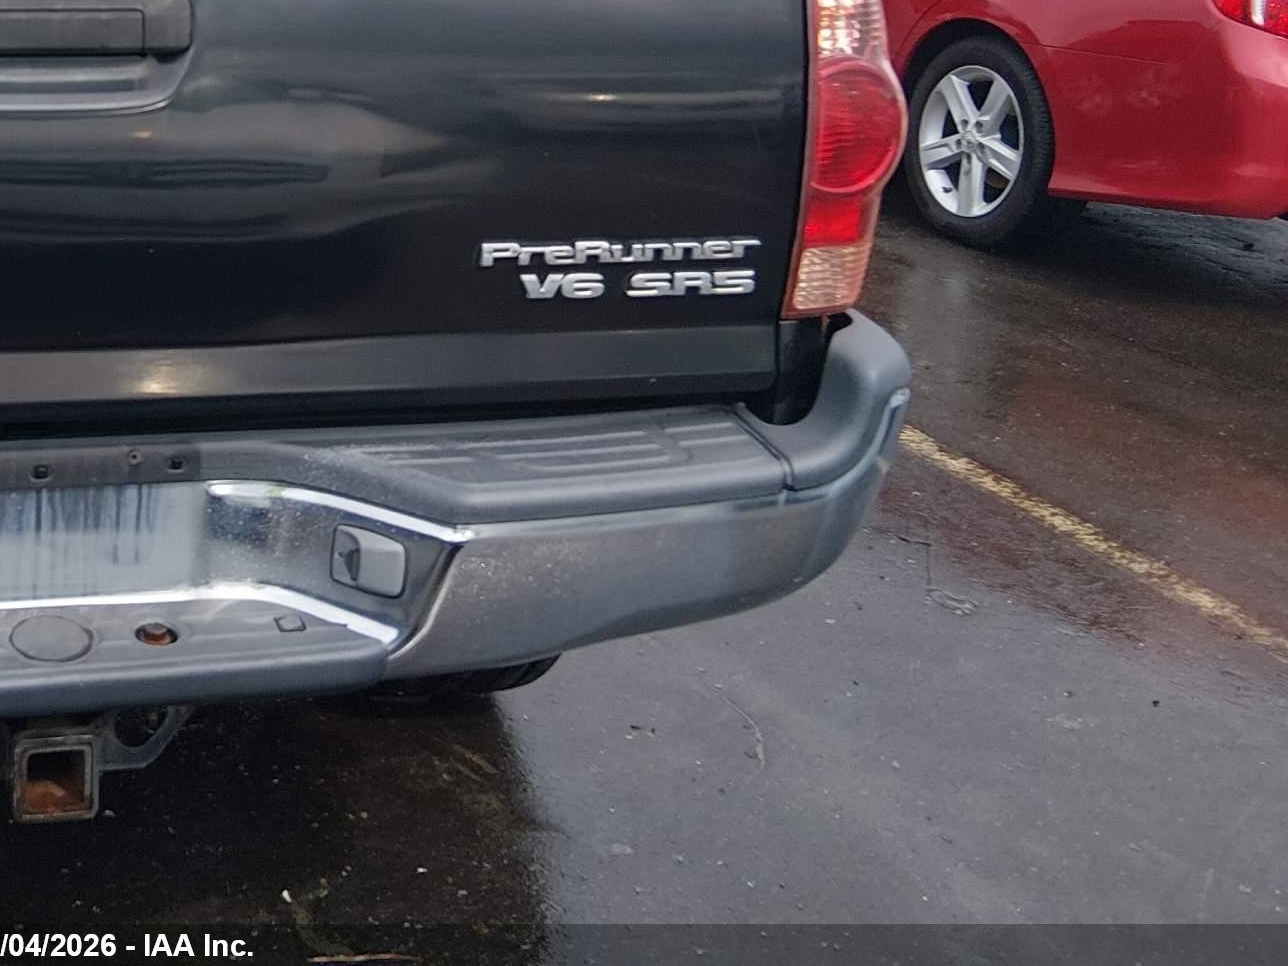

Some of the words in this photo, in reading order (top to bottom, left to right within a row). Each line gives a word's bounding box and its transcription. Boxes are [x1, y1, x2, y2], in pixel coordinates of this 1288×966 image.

[480, 239, 762, 267] PreRunner
[519, 272, 605, 299] V6
[625, 270, 756, 298] SR5
